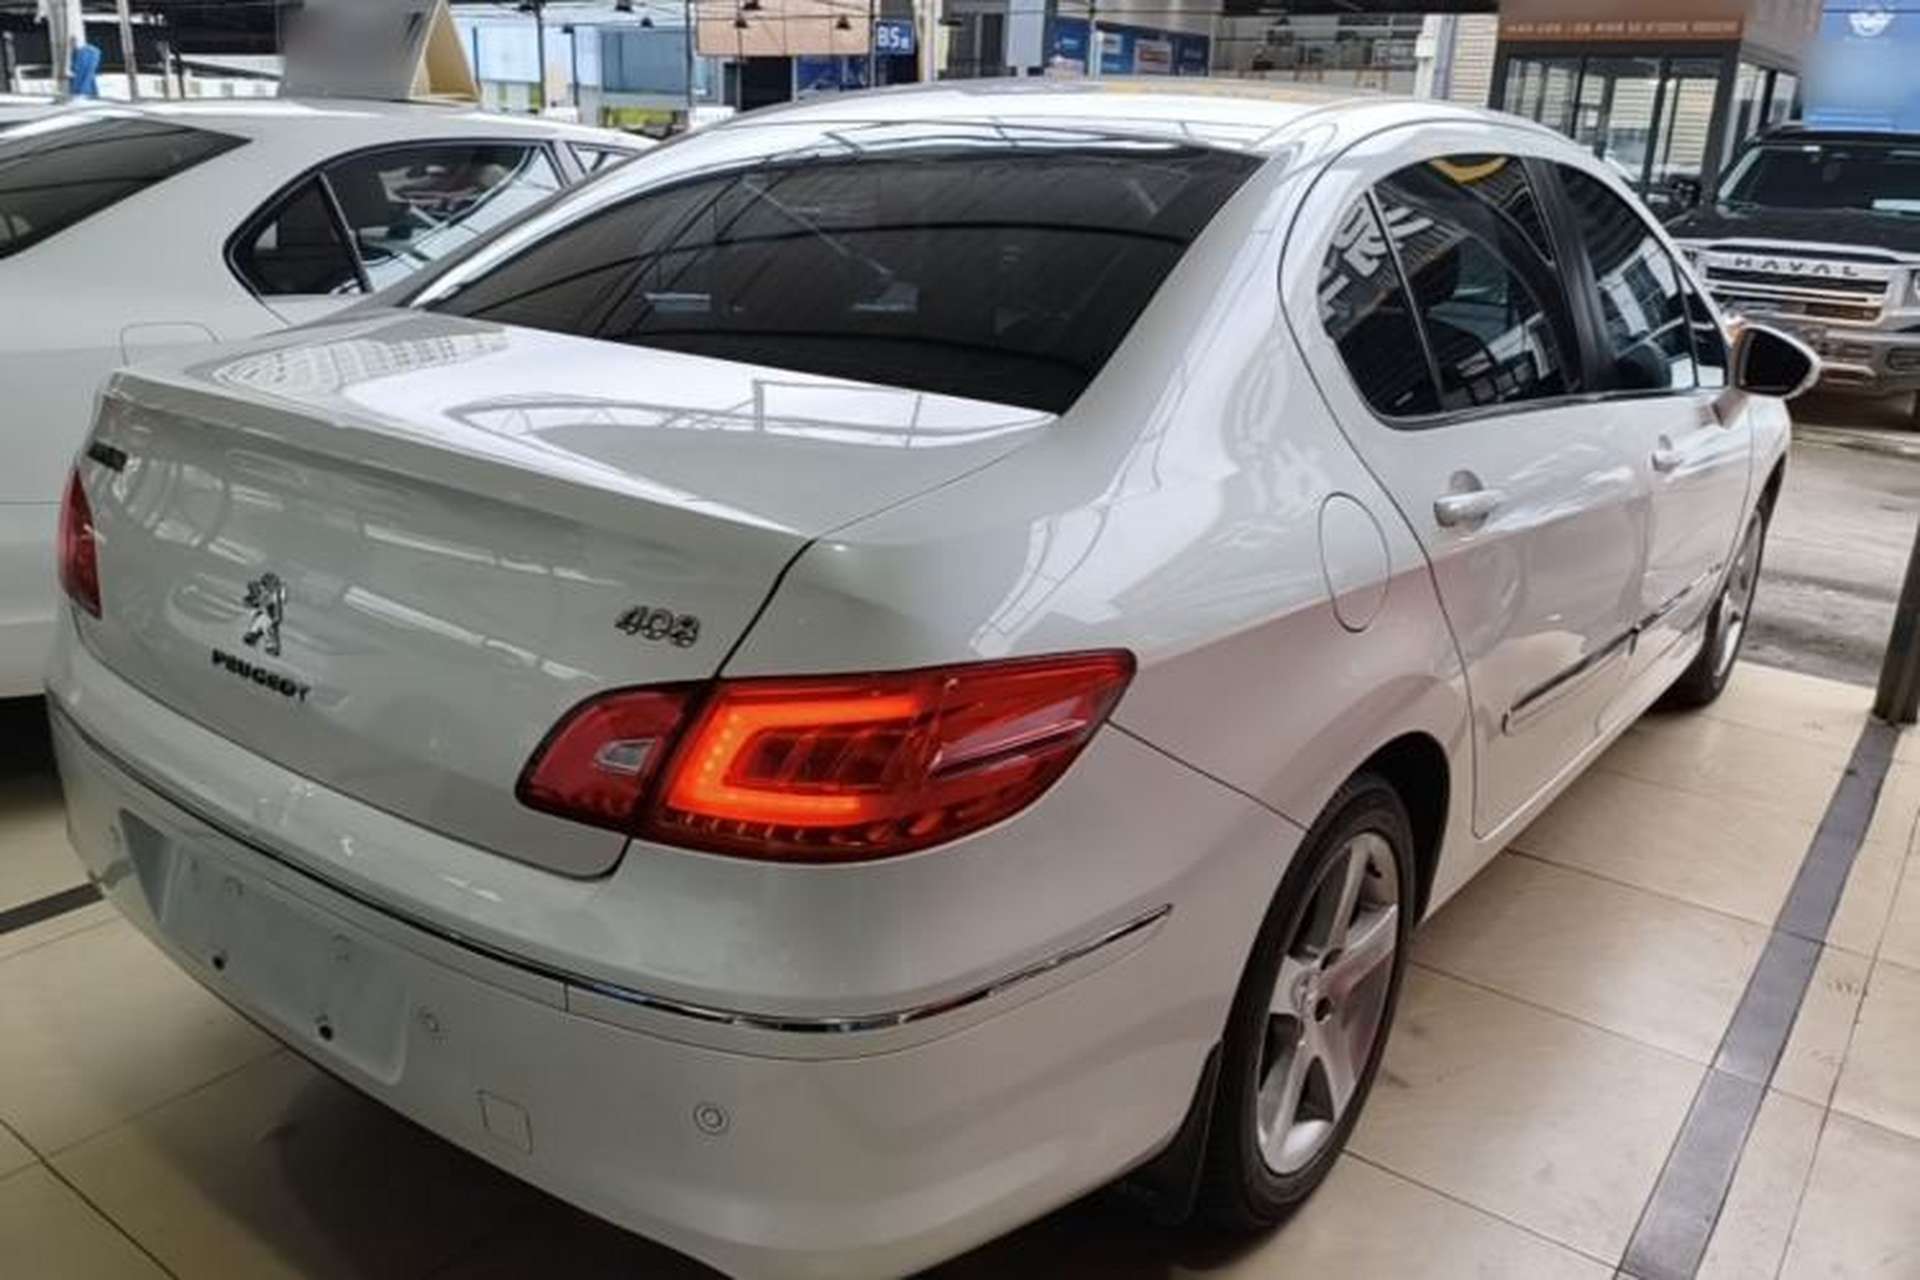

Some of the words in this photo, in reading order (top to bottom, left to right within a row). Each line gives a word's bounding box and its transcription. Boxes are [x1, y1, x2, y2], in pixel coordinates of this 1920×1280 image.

[1734, 256, 1859, 277] HAVAL
[613, 605, 701, 648] 408
[212, 648, 311, 701] PEUGEOT
